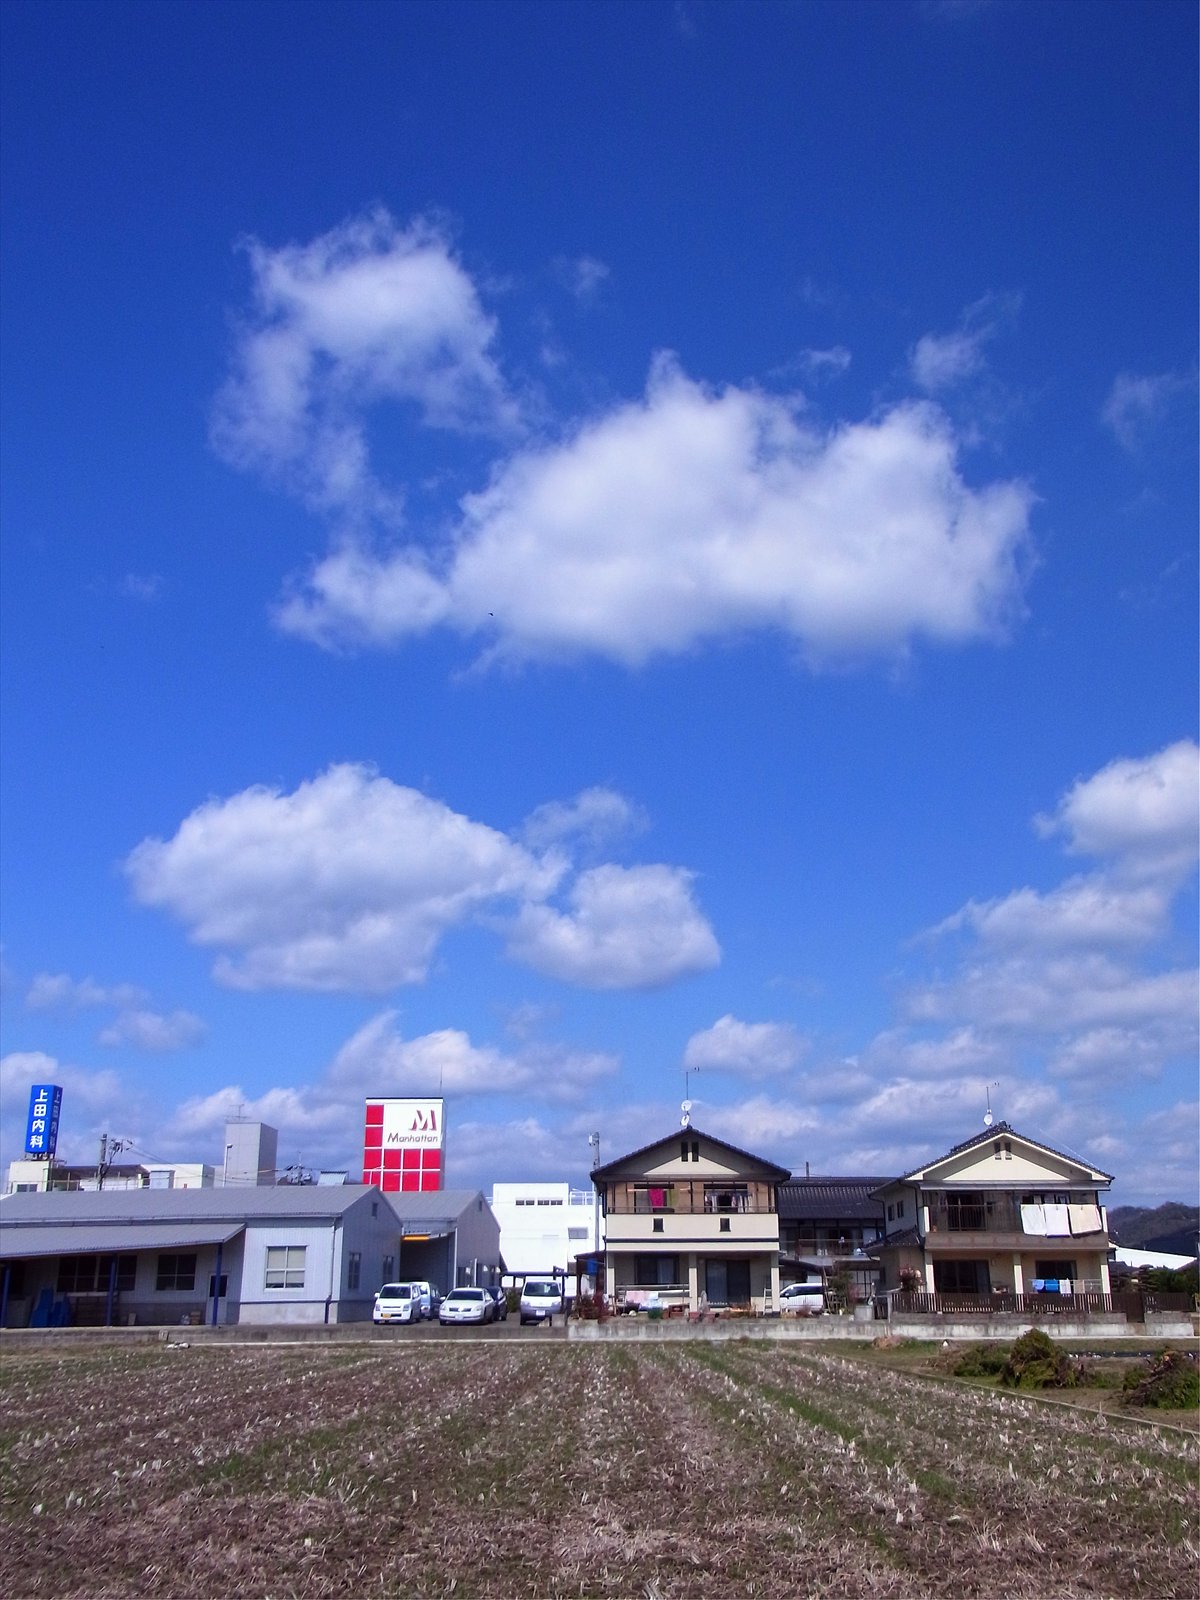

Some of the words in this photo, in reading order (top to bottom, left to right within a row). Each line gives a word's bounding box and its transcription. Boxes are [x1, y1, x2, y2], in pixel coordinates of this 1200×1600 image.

[30, 1088, 48, 1149] 上田内科
[387, 1132, 438, 1143] Manhattan
